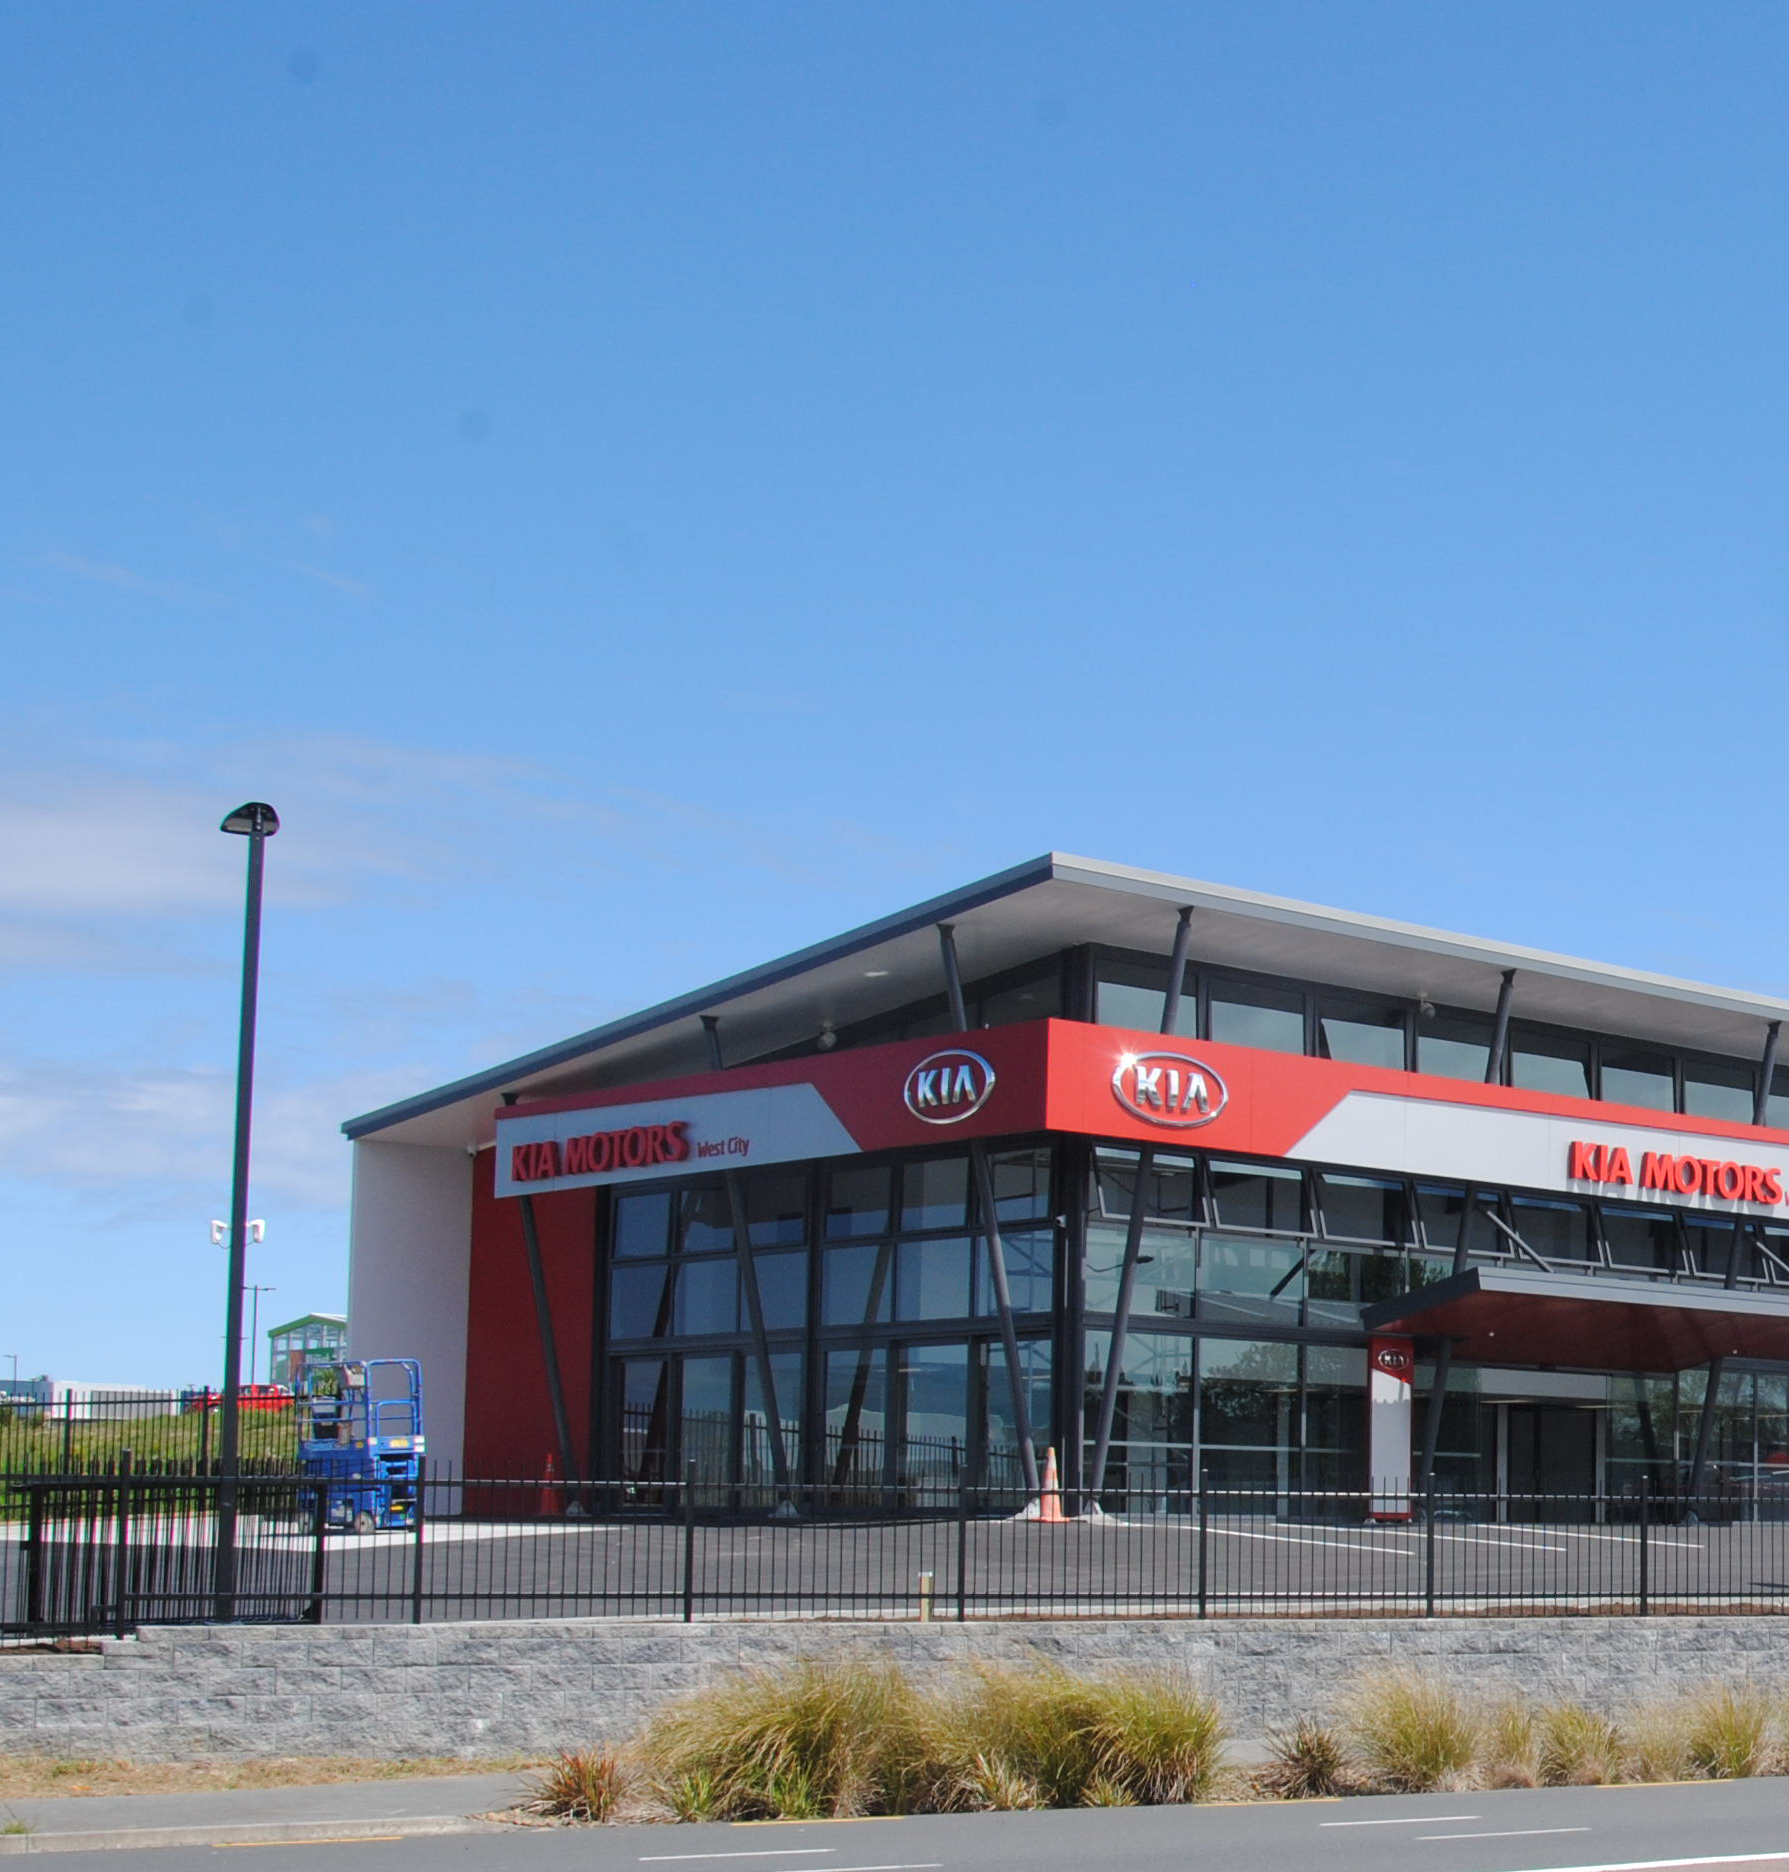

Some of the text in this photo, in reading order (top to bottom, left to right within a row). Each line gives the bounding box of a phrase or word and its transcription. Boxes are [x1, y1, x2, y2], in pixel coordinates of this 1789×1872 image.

[916, 1064, 977, 1108] KIA
[1132, 1063, 1210, 1115] KIA
[511, 1119, 750, 1182] KIA MOTORS West City
[1569, 1140, 1634, 1185] KIA
[1640, 1151, 1784, 1205] MOTORS
[1384, 1353, 1406, 1366] KIA
